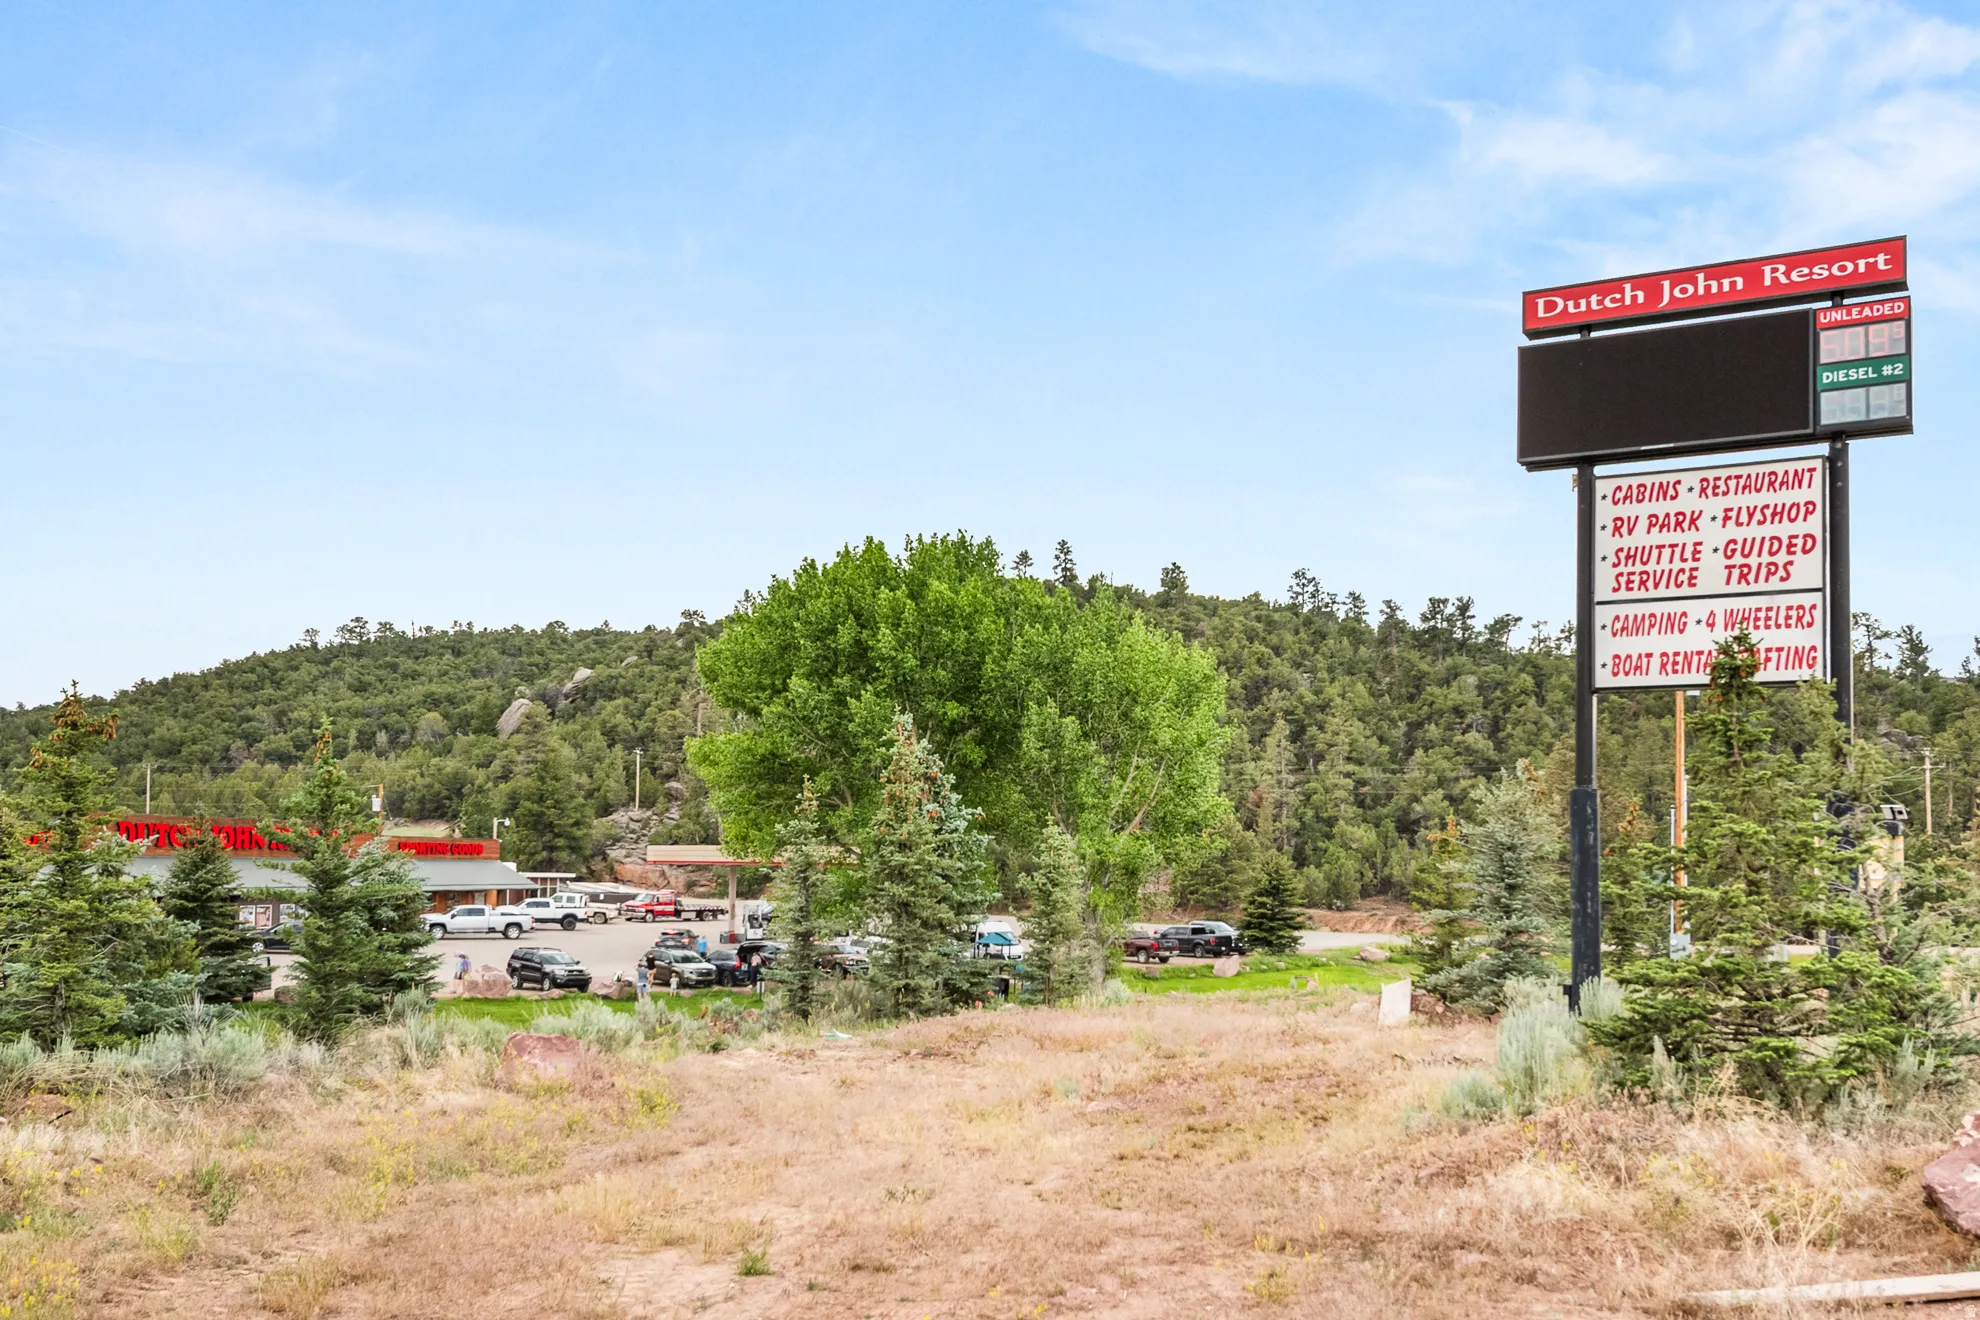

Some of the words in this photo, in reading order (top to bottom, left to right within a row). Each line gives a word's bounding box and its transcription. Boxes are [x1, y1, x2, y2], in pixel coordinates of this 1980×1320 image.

[1535, 282, 1645, 319] Dutch
[1657, 272, 1744, 308] John
[1760, 252, 1893, 287] Resort
[1820, 302, 1905, 323] UNLEADED
[1822, 366, 1878, 384] DIESEL
[1881, 363, 1904, 376] #2
[1611, 479, 1682, 506] CABINS
[1698, 467, 1817, 499] RESTAURANT
[1611, 515, 1640, 539] RV
[1646, 509, 1703, 535] PARK
[1721, 500, 1817, 529] FLYSHOP
[1611, 541, 1704, 569] SHUTTLE
[1722, 533, 1817, 560] GUIDED
[1611, 566, 1700, 593] SERVICE
[1723, 560, 1795, 586] TRIPS
[1611, 610, 1689, 638] CAMPING
[1705, 609, 1717, 633] 4
[1723, 603, 1818, 632] WHEELERS
[1611, 652, 1654, 678] BOAT
[1658, 649, 1720, 677] RENTA
[1739, 645, 1819, 672] FTING
[399, 841, 451, 855] SPORTING
[451, 843, 484, 855] GOODS
